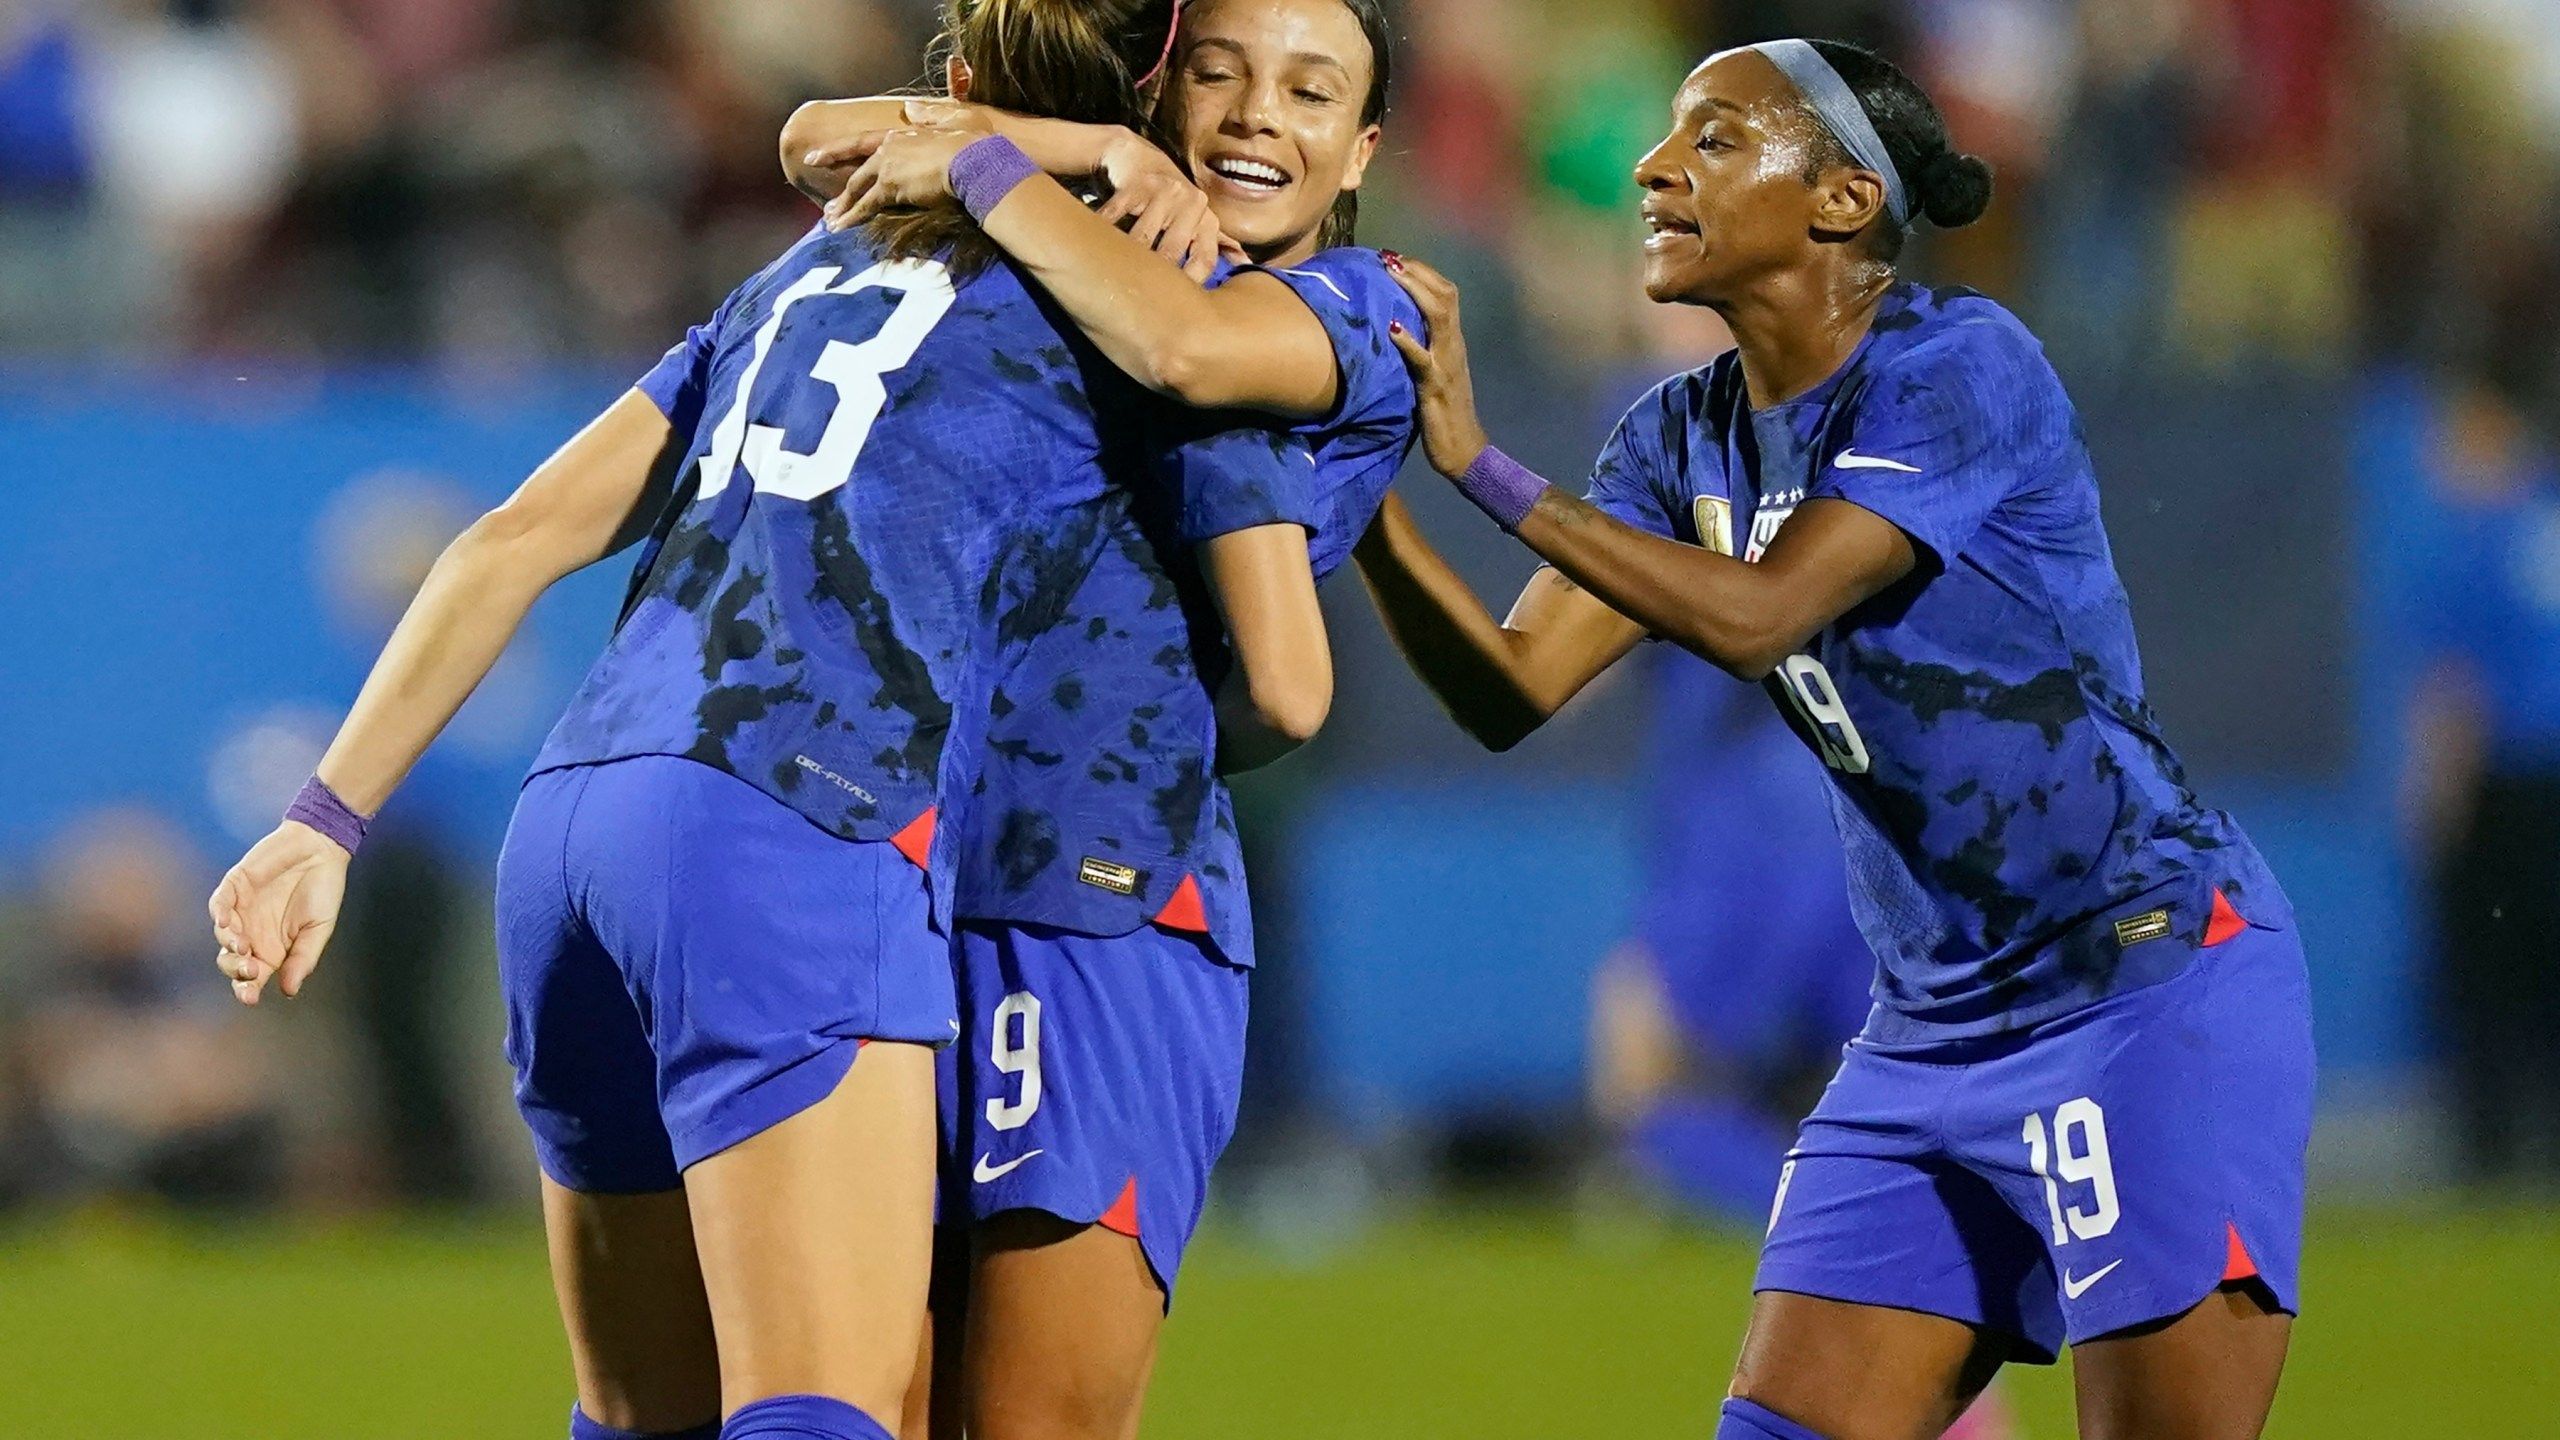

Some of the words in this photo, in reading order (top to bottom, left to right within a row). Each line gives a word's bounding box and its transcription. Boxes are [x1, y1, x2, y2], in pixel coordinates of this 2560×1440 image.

[697, 256, 957, 502] 13
[985, 990, 1042, 1132] 9
[2022, 1096, 2121, 1246] 19
